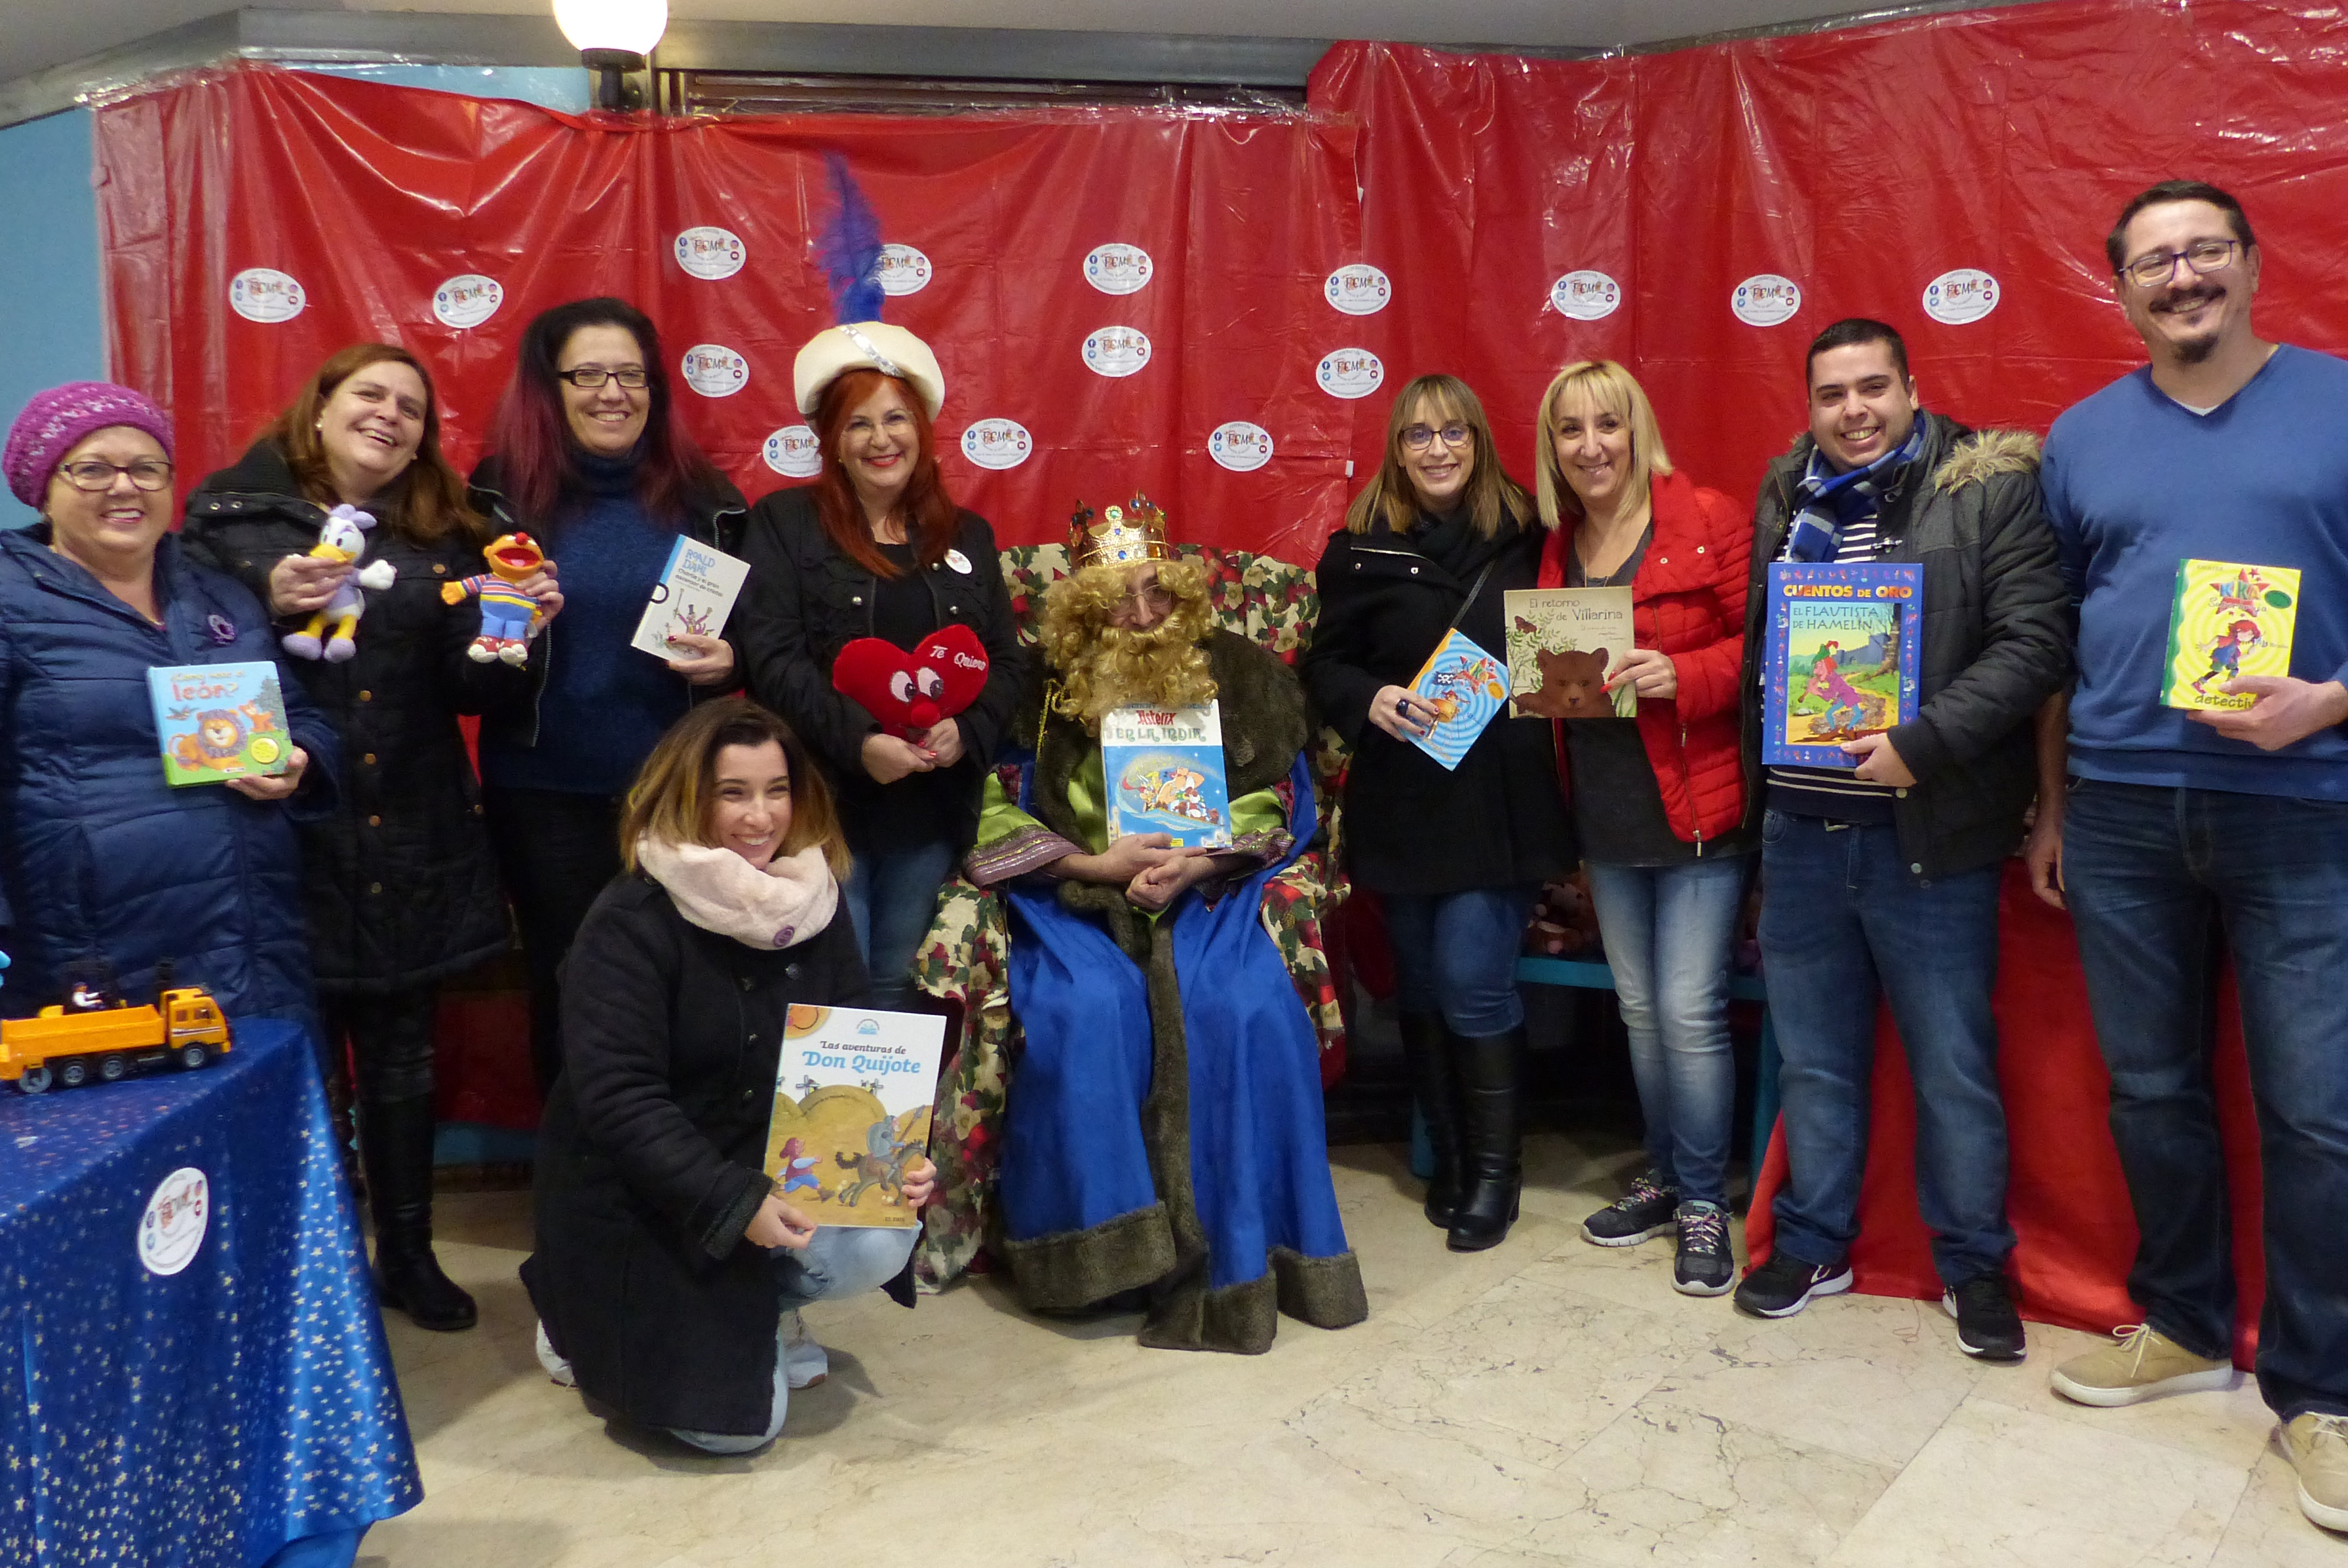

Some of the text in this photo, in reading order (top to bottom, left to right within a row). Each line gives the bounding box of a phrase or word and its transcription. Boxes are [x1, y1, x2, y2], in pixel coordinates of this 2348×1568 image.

[685, 548, 716, 568] ROALD
[682, 558, 707, 577] DAHL
[1783, 584, 1913, 598] CUENTOS DE ORO
[1530, 598, 1580, 608] El retorno
[1556, 607, 1623, 621] de Villarina
[1793, 606, 1879, 617] EL FLAUTISTA
[1793, 621, 1803, 629] DE
[930, 645, 986, 671] Te Quiero
[820, 1041, 906, 1055] Las aventuras de
[802, 1051, 921, 1076] Don Quijote
